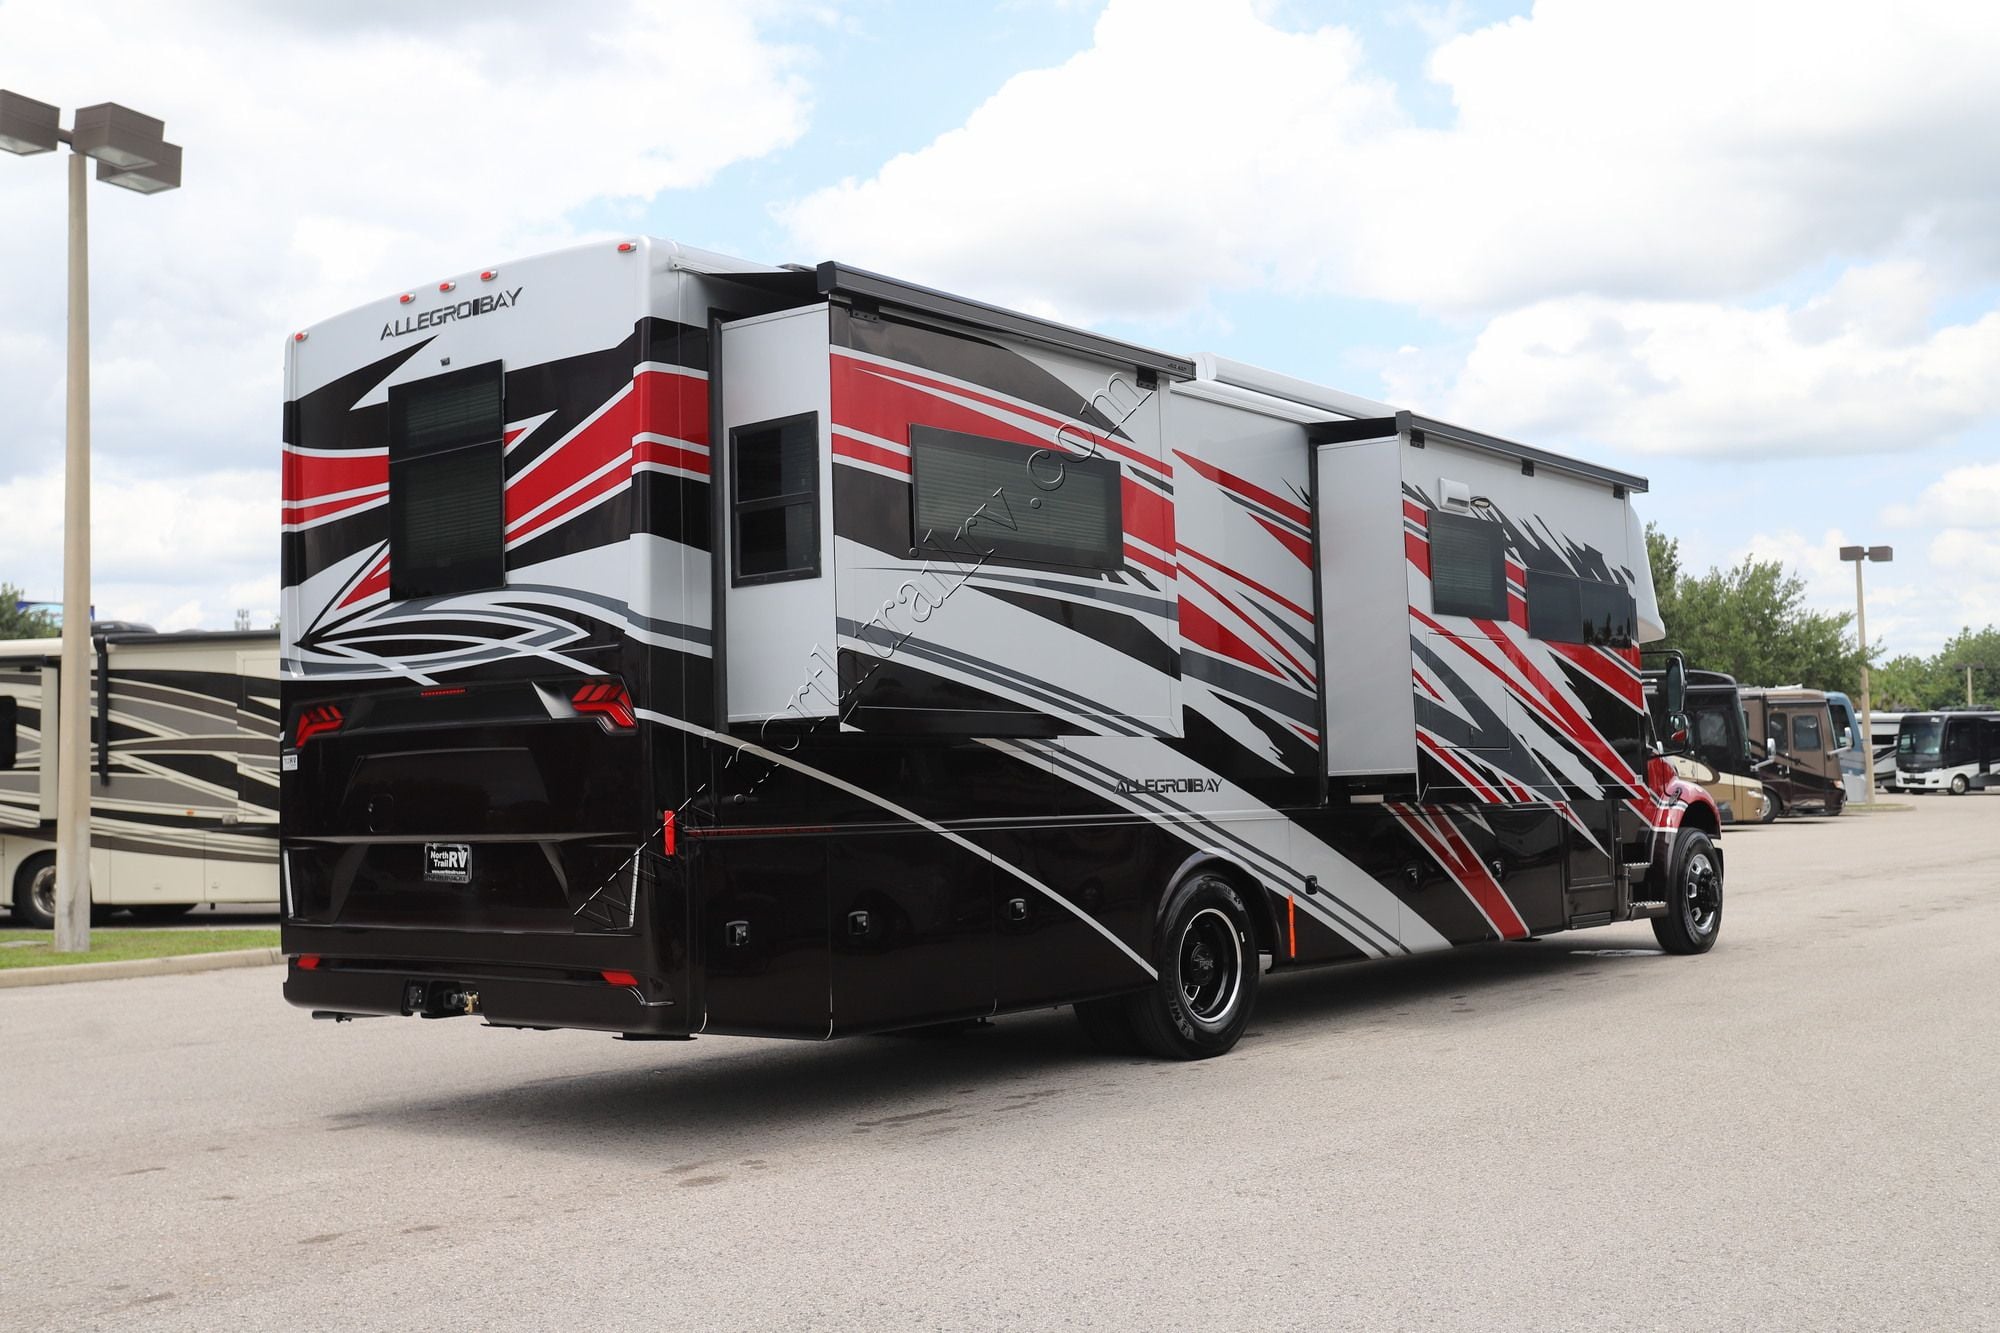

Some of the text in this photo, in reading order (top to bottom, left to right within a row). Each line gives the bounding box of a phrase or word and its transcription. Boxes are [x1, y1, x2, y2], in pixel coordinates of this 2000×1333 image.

[430, 850, 448, 859] North
[433, 859, 448, 867] Trail
[448, 851, 467, 868] RV
